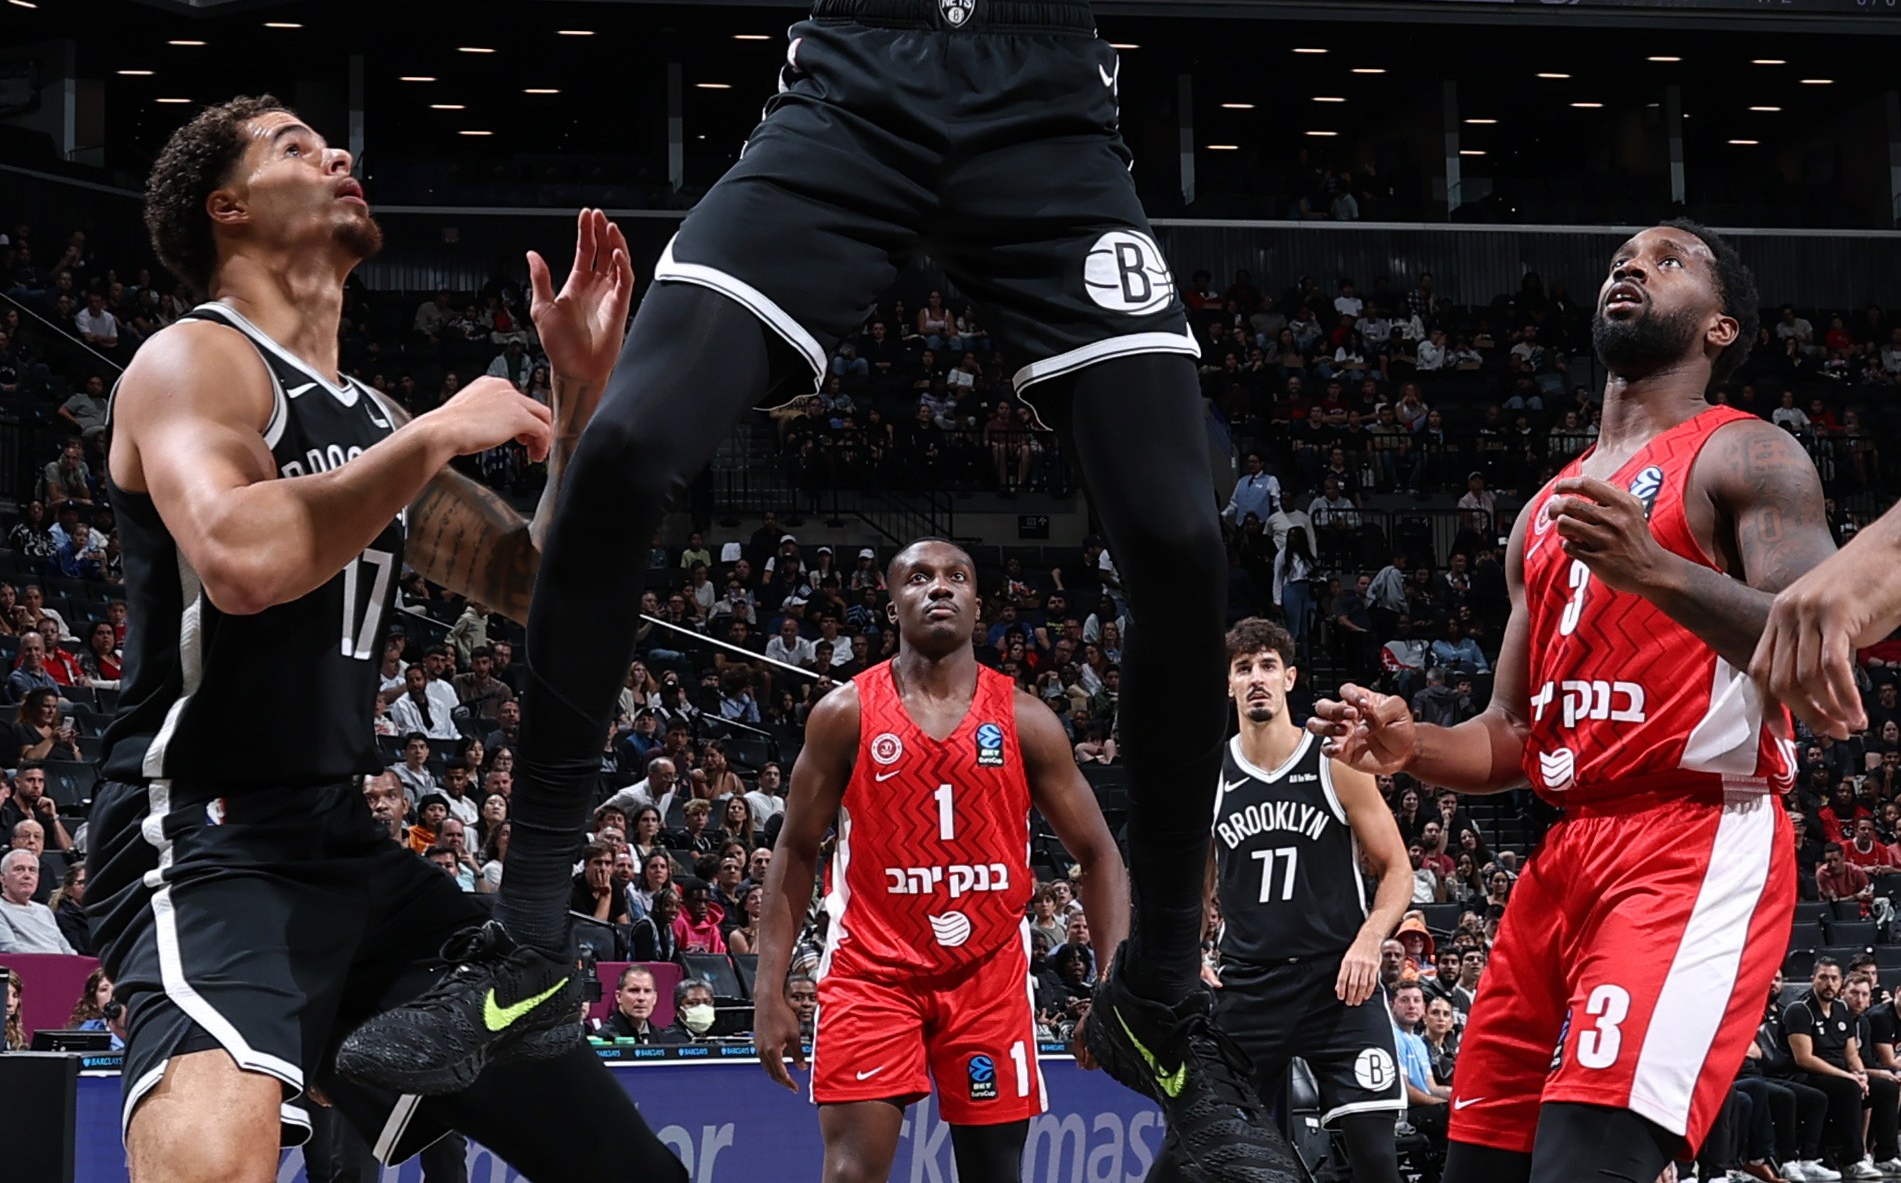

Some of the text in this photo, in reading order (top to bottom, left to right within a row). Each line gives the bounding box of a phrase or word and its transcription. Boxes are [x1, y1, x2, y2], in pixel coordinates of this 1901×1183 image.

[1113, 242, 1152, 304] B
[343, 548, 394, 660] 17
[1559, 559, 1591, 637] 3
[1561, 679, 1647, 729] בנק
[933, 783, 956, 841] 1
[1216, 800, 1330, 850] BROOKLYN
[885, 862, 1010, 899] בנק יהב
[1251, 846, 1298, 904] 77
[640, 1049, 665, 1057] BARCLAYS
[684, 1048, 708, 1056] BARCLAYS
[727, 1047, 750, 1055] BARCLAYS
[1575, 983, 1631, 1071] 3
[1009, 1040, 1031, 1098] 1
